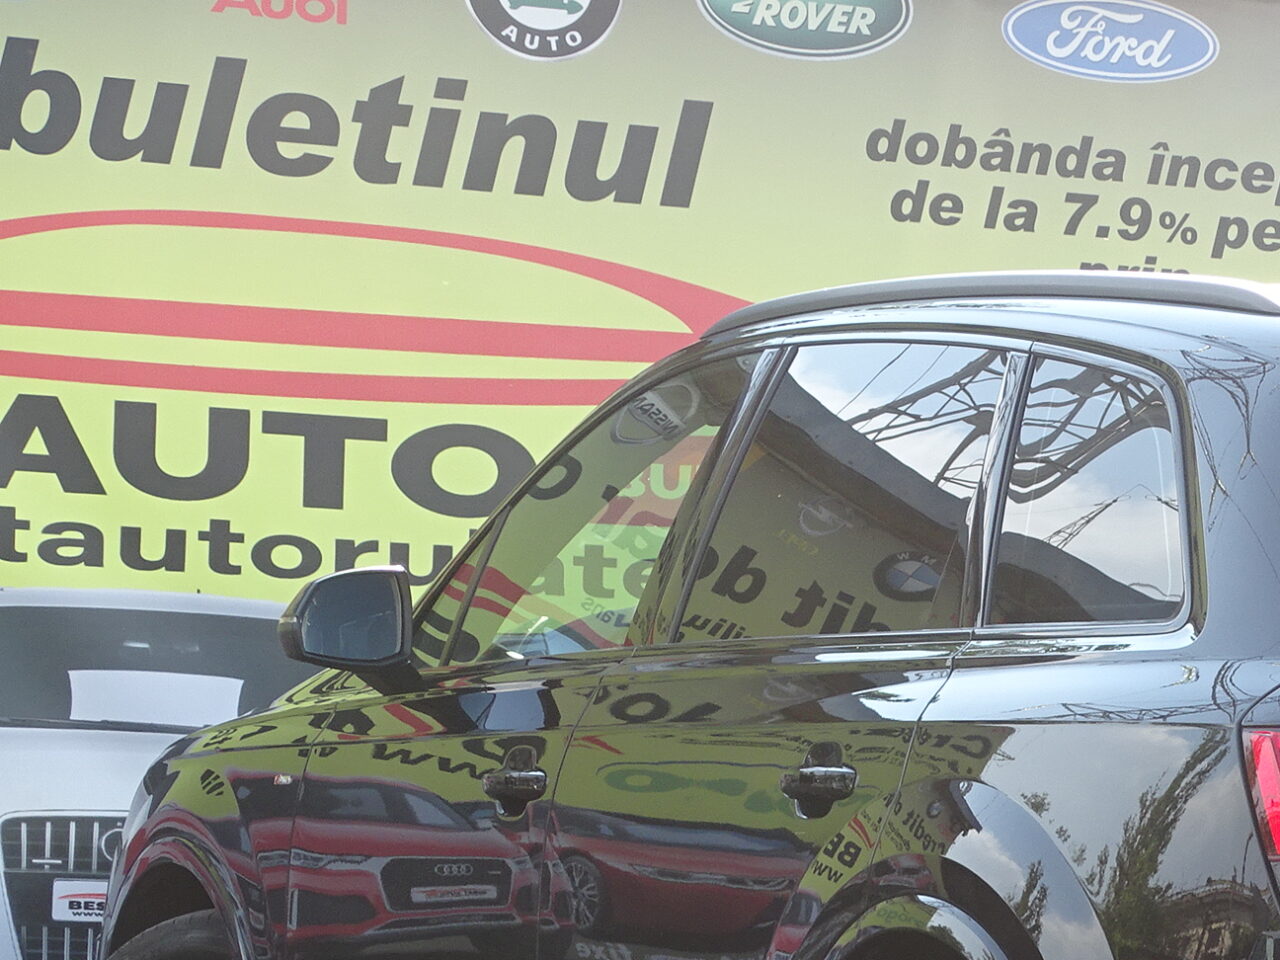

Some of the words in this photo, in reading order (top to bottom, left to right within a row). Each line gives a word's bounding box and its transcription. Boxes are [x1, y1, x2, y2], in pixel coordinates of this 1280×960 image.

[501, 24, 583, 52] AUTO
[752, 2, 876, 35] ROVER
[1046, 4, 1176, 69] Ford
[0, 36, 714, 208] buletinul
[865, 119, 1127, 182] dobânda
[890, 179, 964, 227] de
[984, 186, 1039, 232] la
[0, 393, 537, 518] AUTO
